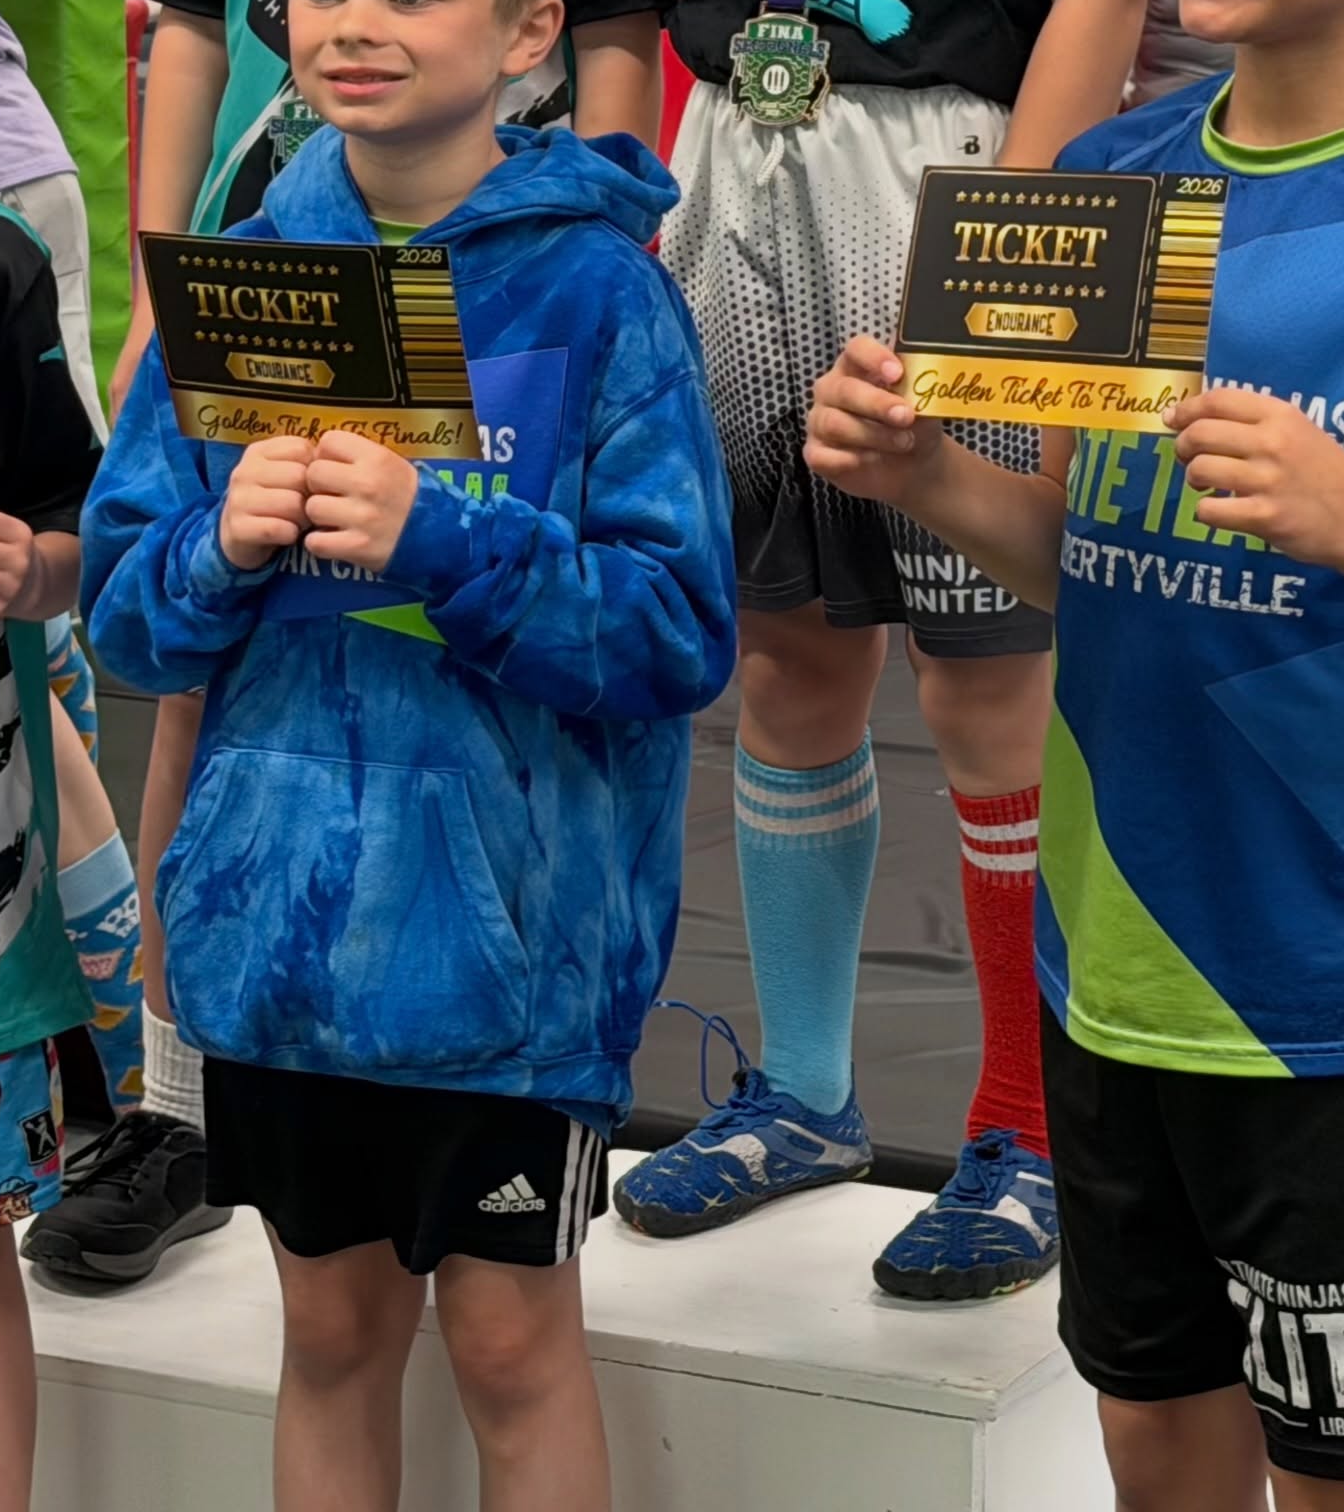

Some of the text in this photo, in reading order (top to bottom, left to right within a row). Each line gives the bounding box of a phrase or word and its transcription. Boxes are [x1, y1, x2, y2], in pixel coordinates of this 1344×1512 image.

[757, 23, 804, 40] FINA
[1176, 177, 1223, 196] 2026
[395, 248, 442, 264] 2026
[954, 221, 1107, 268] TICKET
[187, 281, 340, 327] TICKET
[986, 310, 1057, 336] ENDURANCE
[246, 357, 314, 385] ENDURANCE
[912, 369, 995, 412] Golden
[1000, 375, 1063, 411] Ticket
[1063, 379, 1096, 406] To
[198, 405, 276, 438] Golden
[372, 421, 464, 446] Finals!
[900, 579, 1018, 614] UNITED
[479, 1197, 546, 1213] adidas
